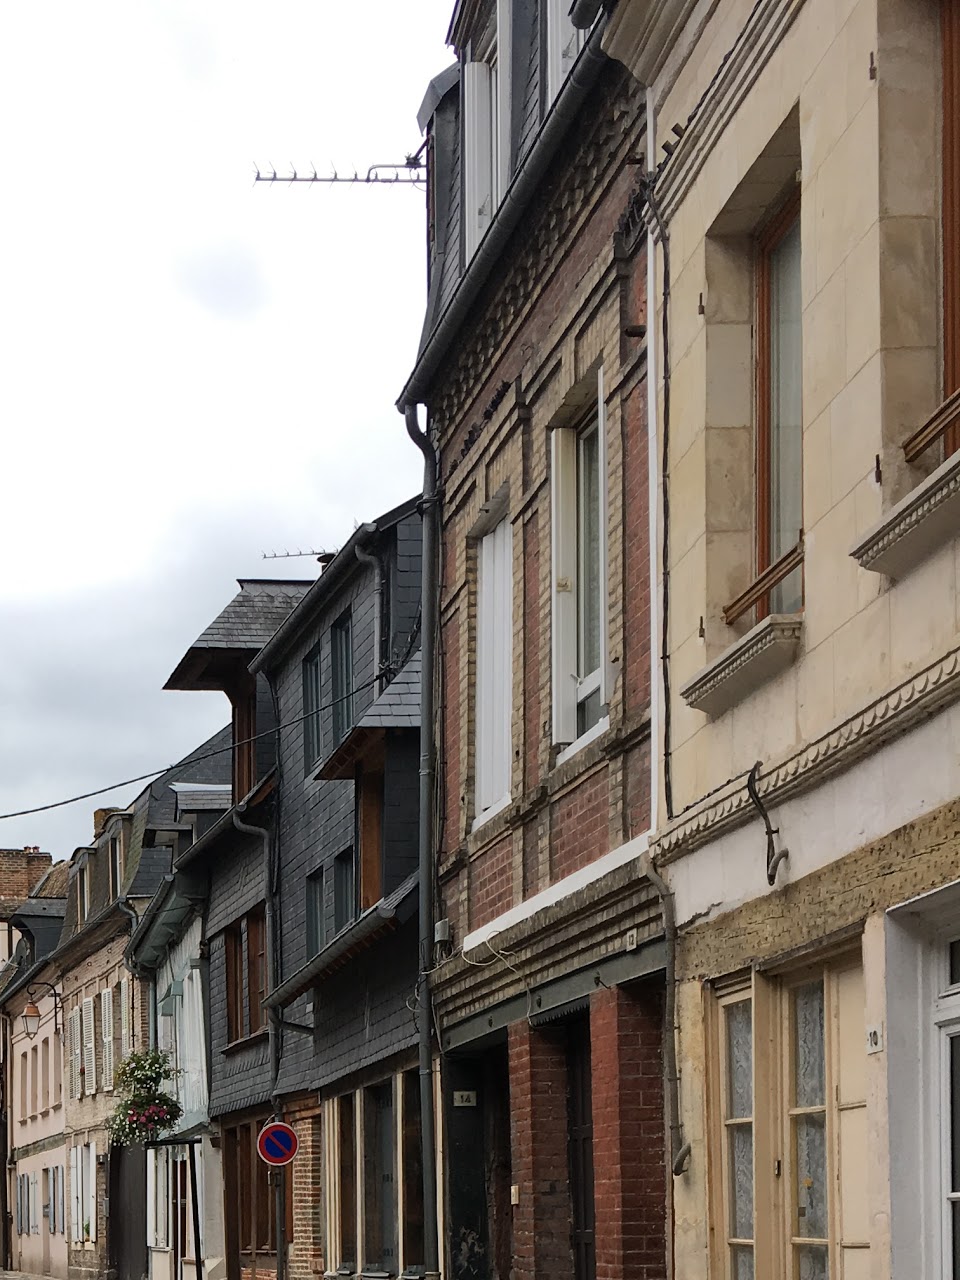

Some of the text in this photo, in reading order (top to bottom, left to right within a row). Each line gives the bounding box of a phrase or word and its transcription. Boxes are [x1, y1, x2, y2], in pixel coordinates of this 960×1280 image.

[628, 934, 635, 946] 12
[869, 1030, 878, 1047] 10
[460, 1094, 472, 1103] 14
